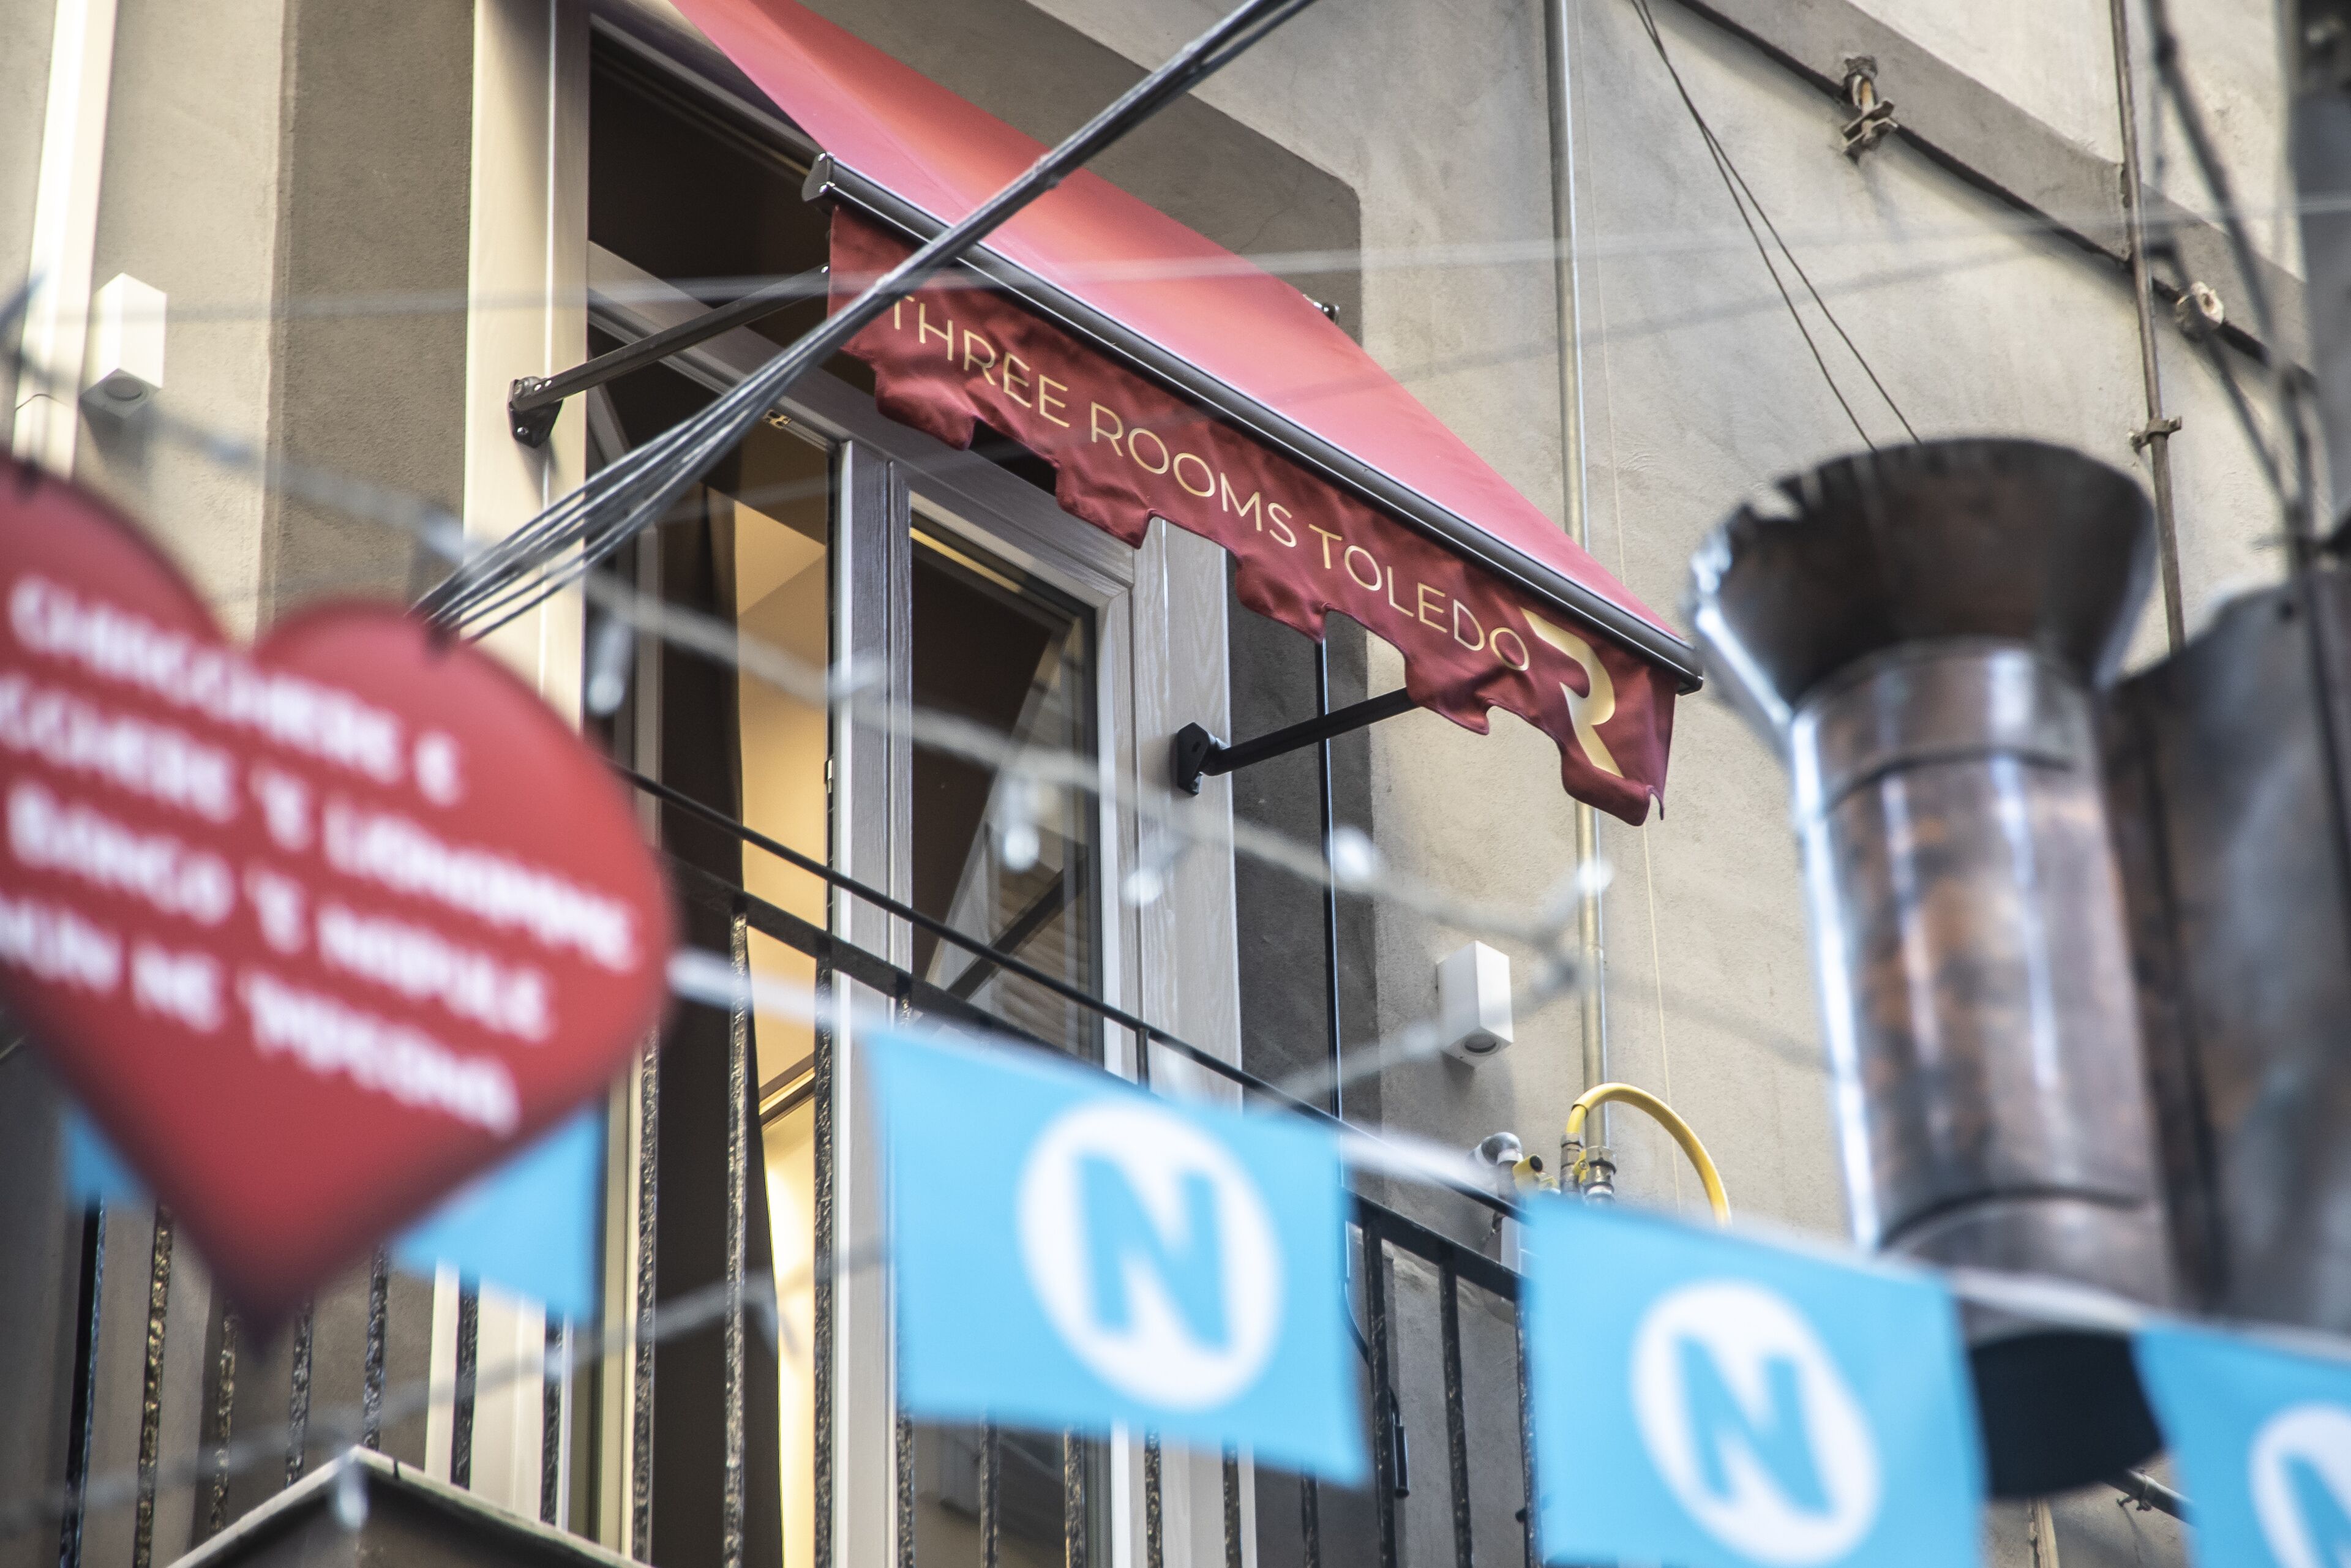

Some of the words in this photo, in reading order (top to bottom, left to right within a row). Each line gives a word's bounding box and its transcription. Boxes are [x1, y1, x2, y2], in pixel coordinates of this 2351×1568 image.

[1090, 401, 1297, 547] ROOMS
[1308, 523, 1530, 672] TOLEDO
[1076, 1151, 1229, 1357] N
